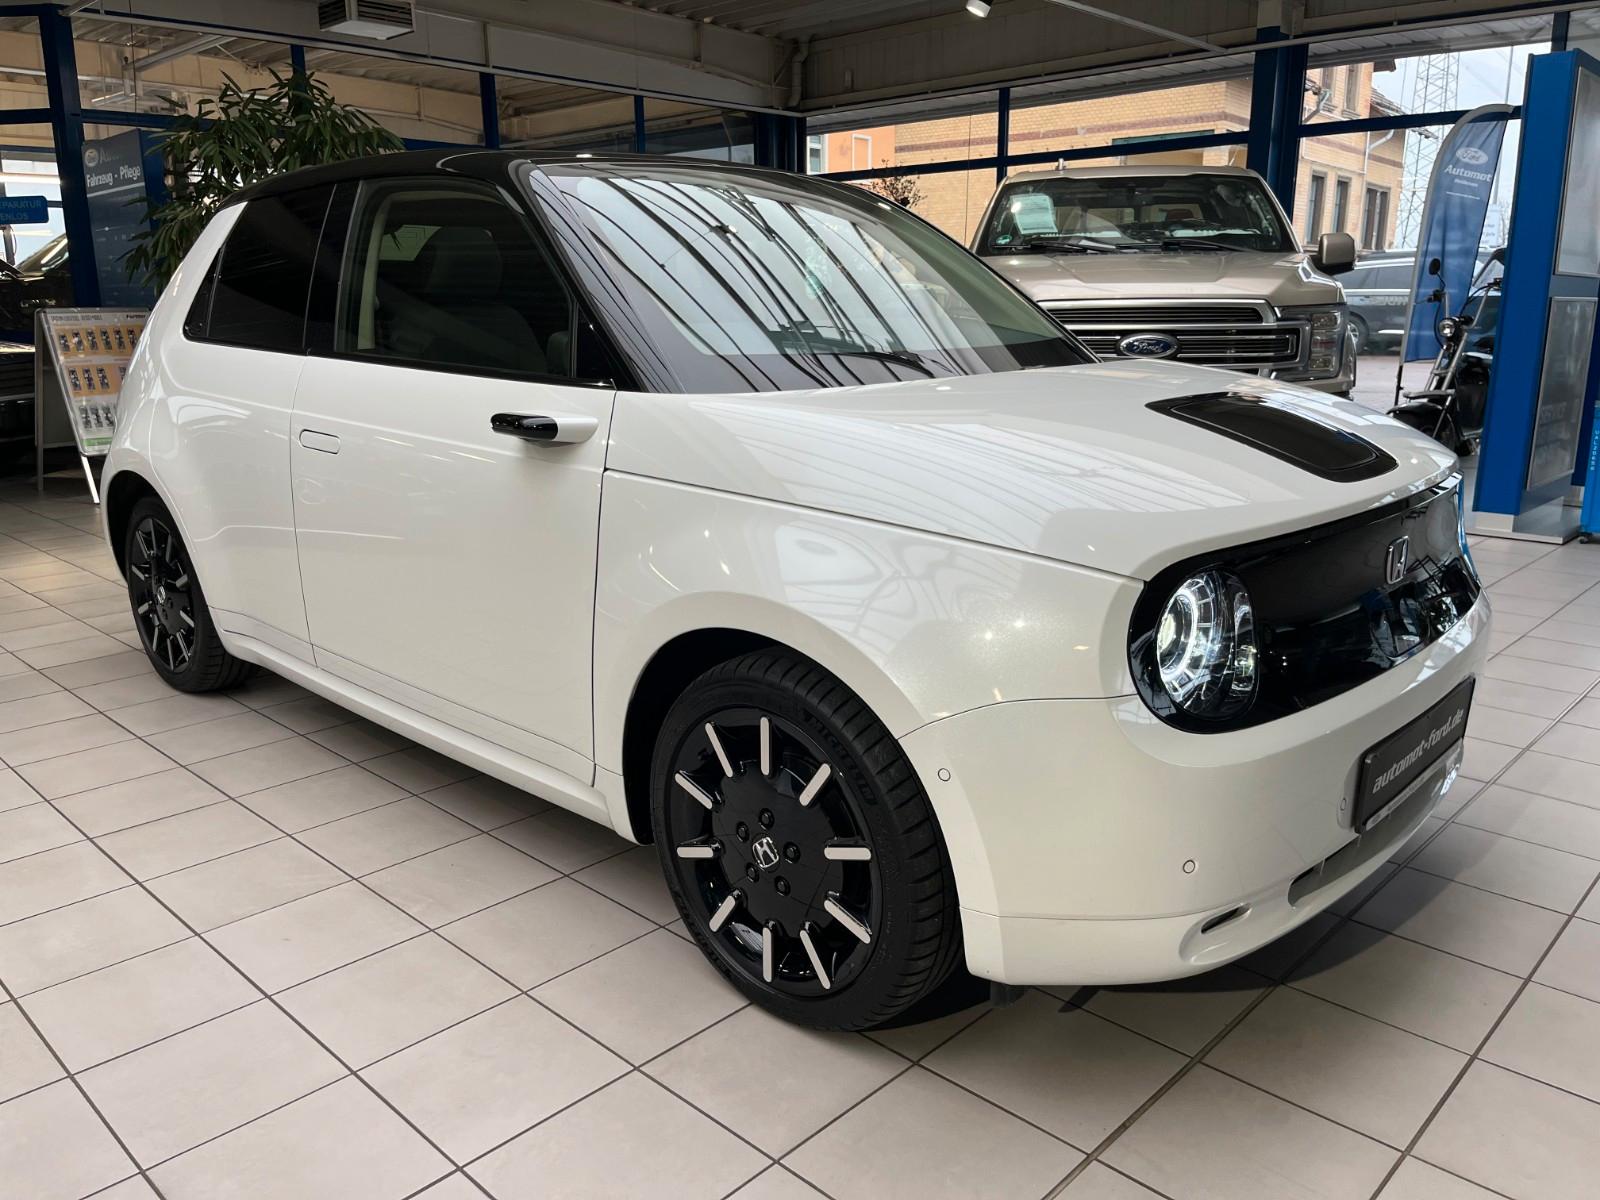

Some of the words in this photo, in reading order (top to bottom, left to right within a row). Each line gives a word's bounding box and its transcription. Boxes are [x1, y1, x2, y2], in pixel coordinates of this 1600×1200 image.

[86, 172, 113, 188] Fahrzeug
[119, 165, 141, 181] Pflege
[1444, 164, 1492, 182] Automot
[1372, 708, 1464, 794] automot-ford.de
